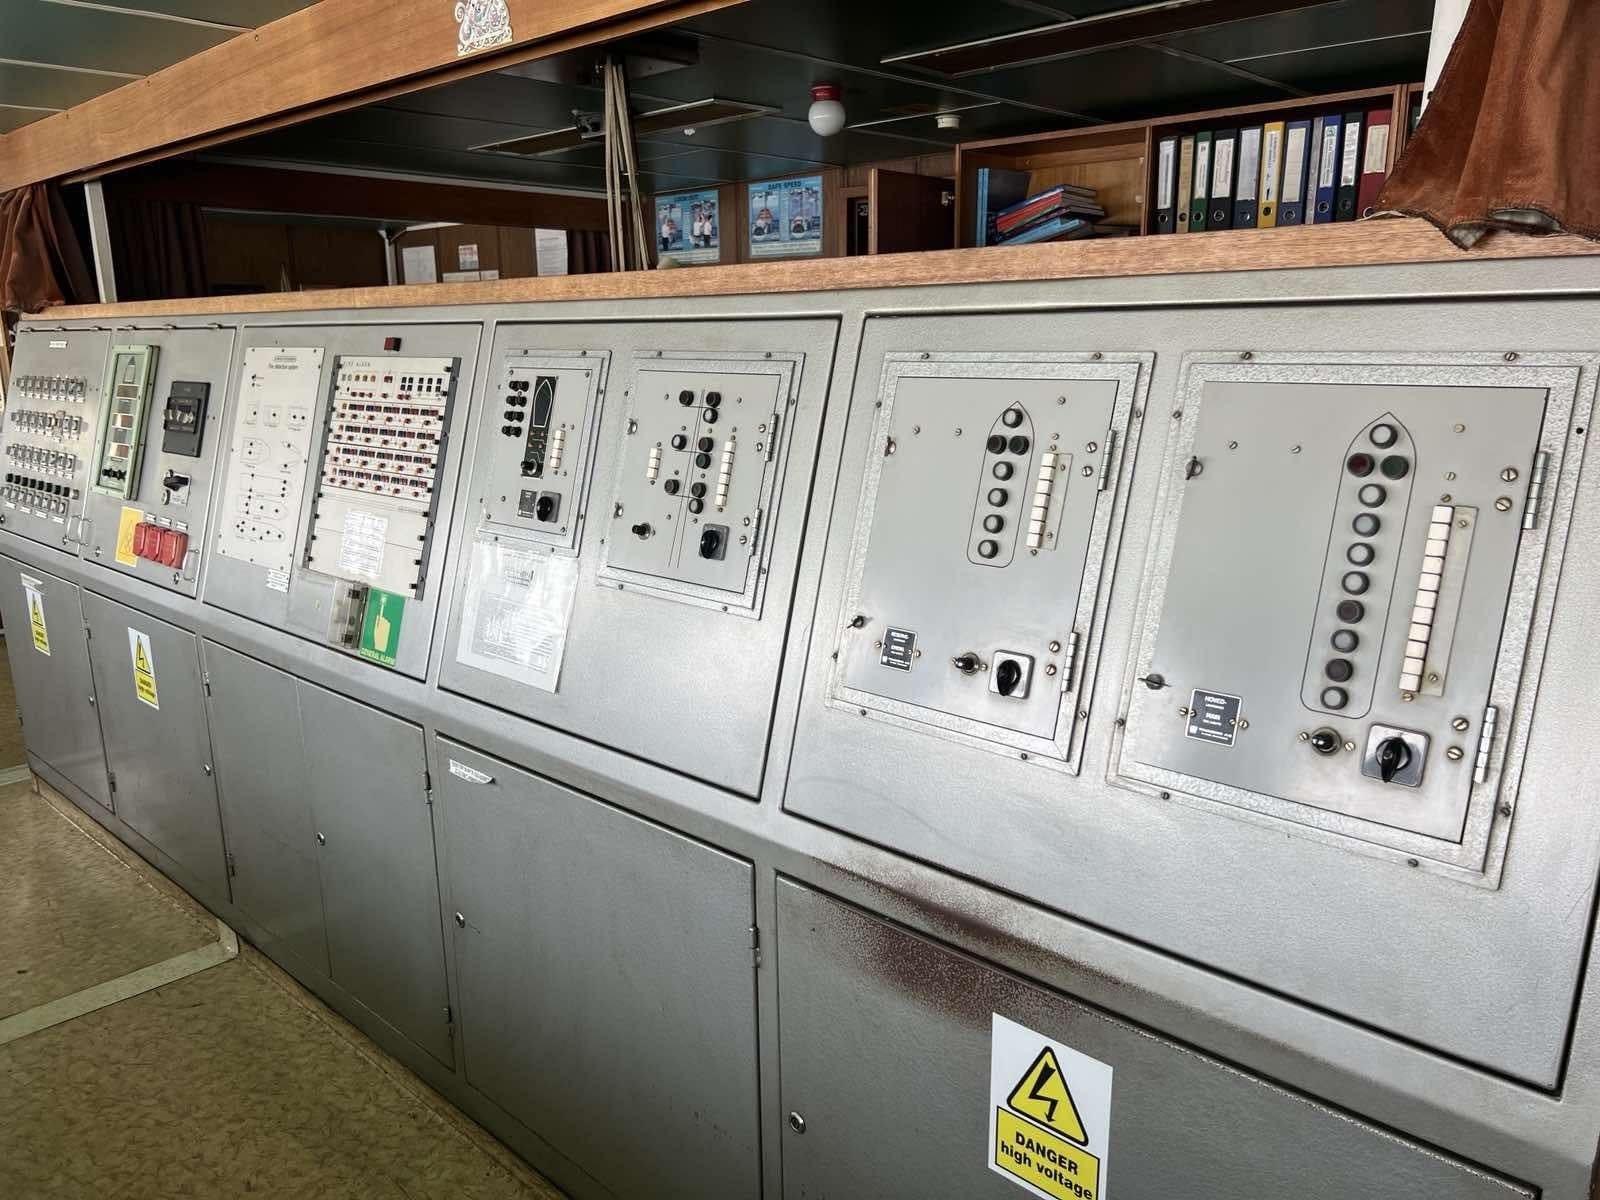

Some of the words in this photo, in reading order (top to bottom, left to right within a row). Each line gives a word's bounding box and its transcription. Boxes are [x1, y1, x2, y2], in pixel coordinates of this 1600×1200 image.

[1000, 1140, 1032, 1168] high
[1036, 1162, 1093, 1200] voltage
[1015, 1131, 1079, 1175] DANGER
